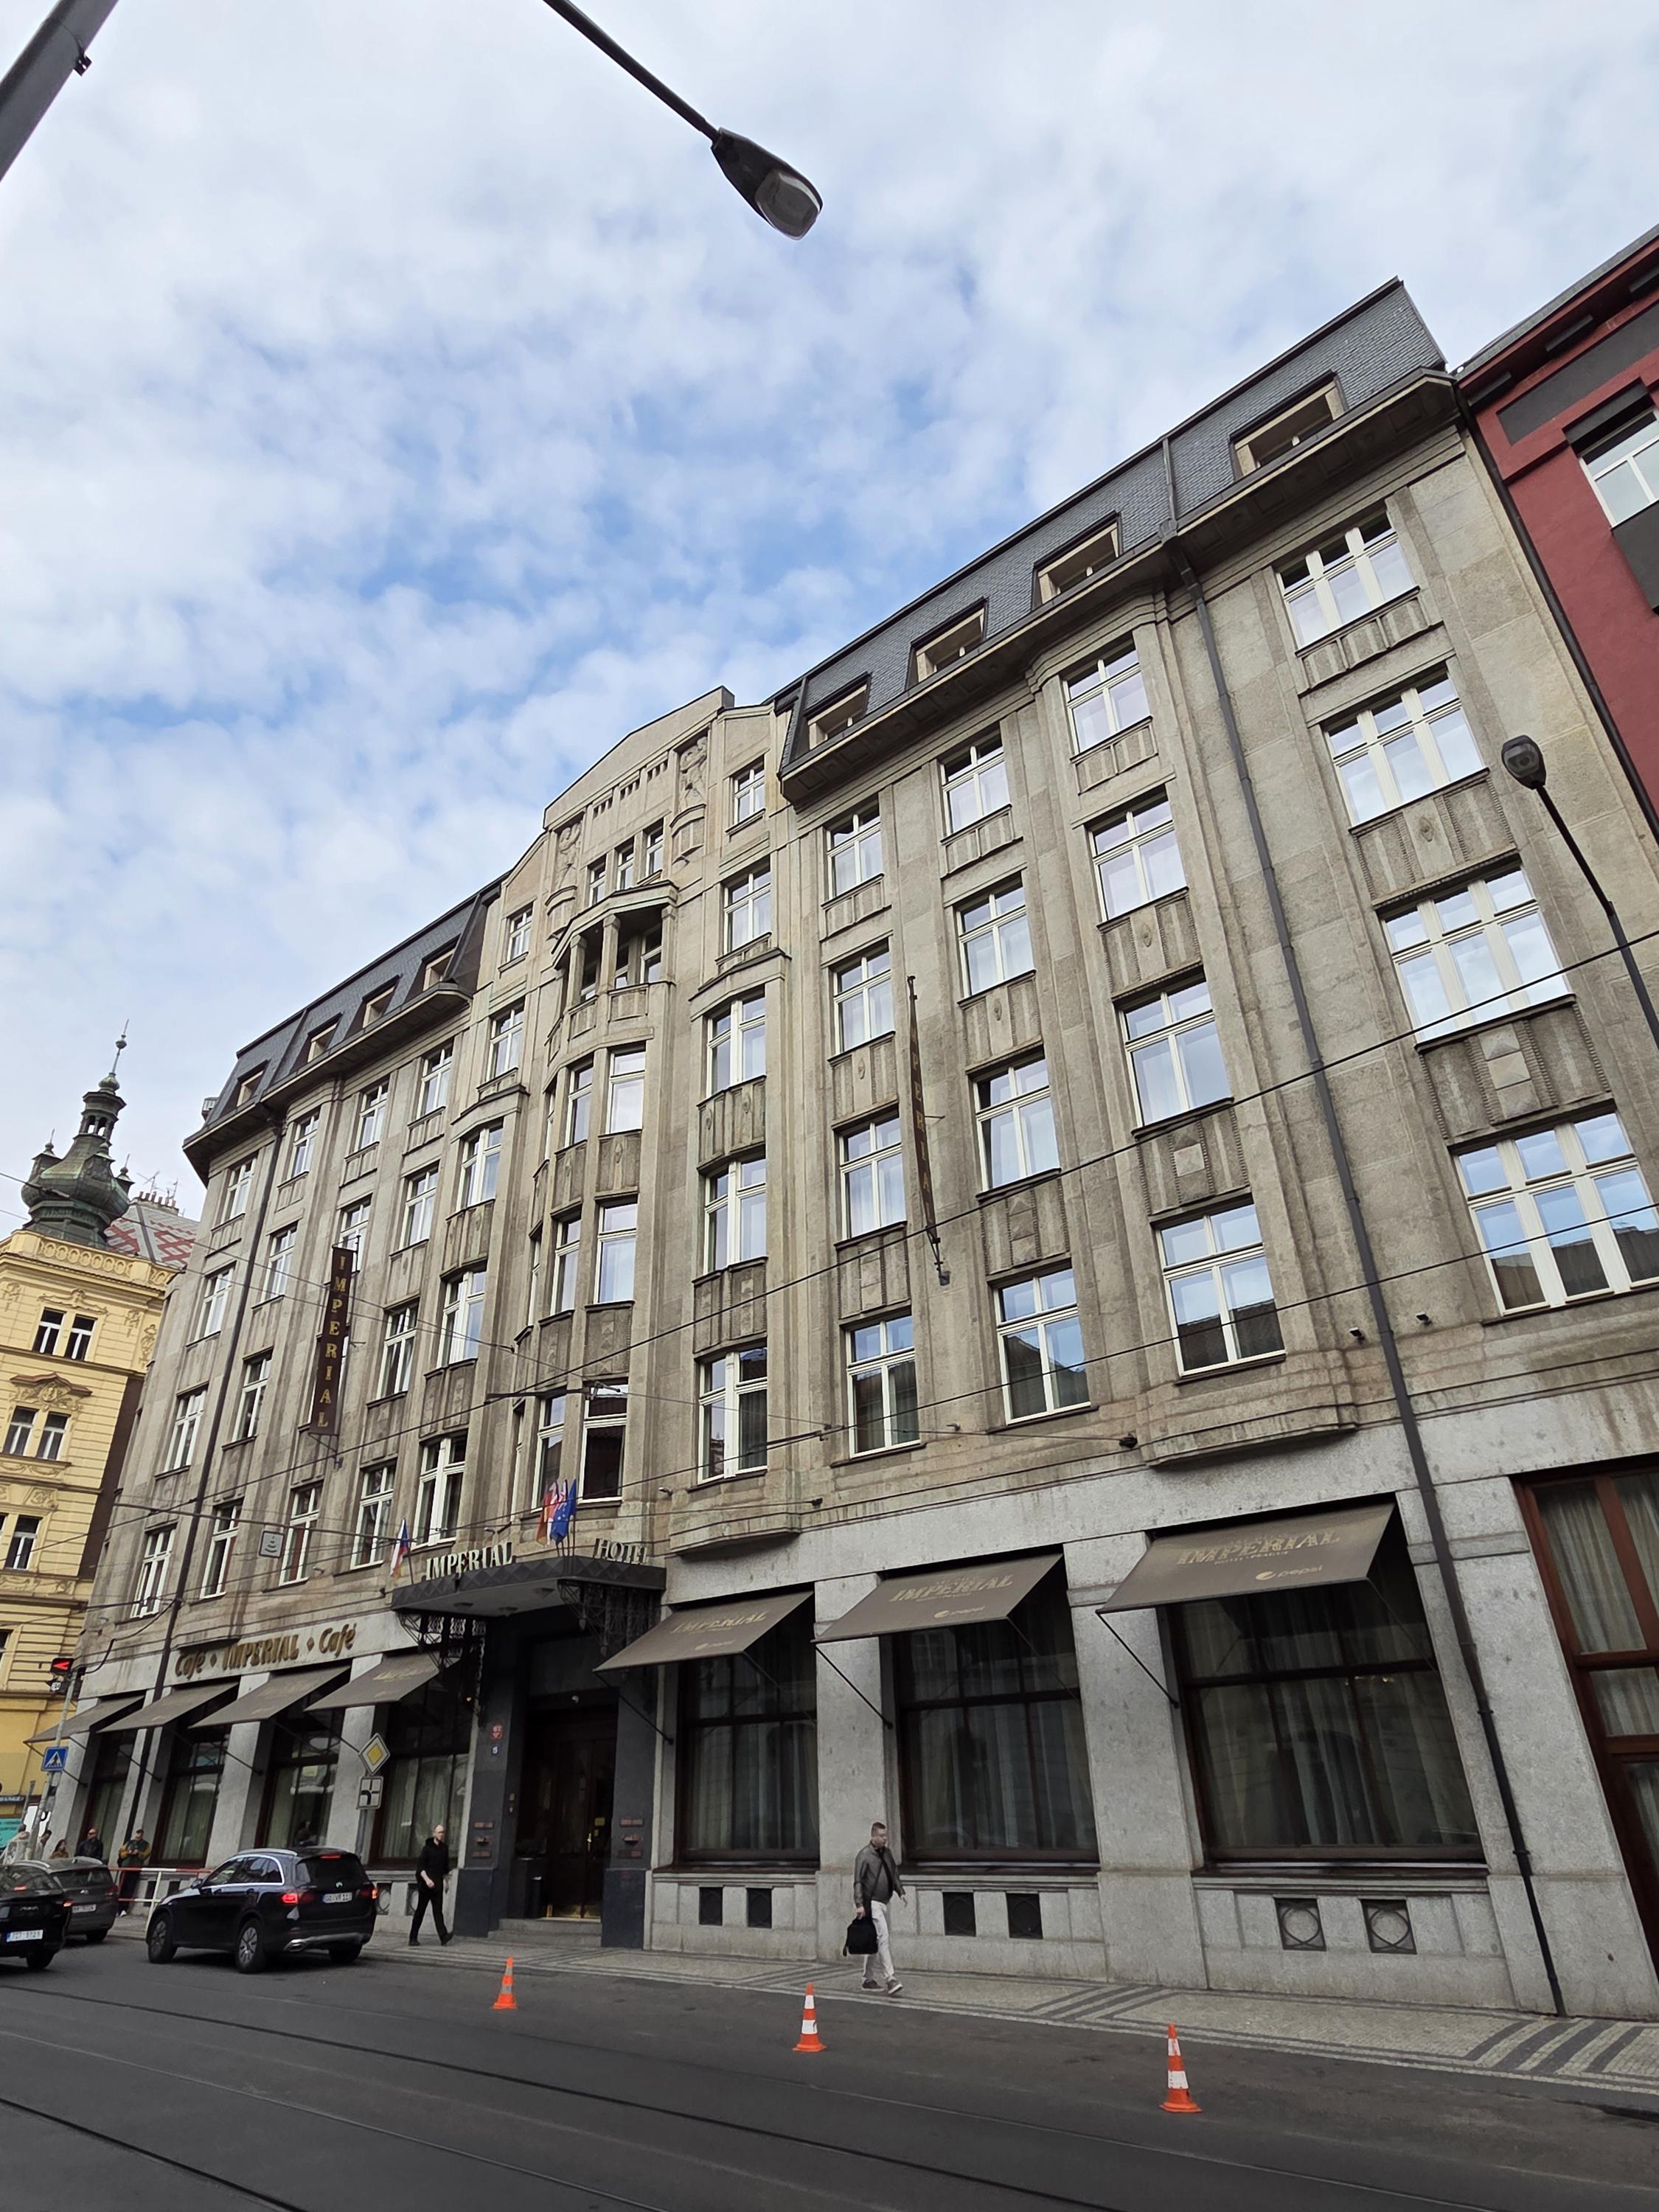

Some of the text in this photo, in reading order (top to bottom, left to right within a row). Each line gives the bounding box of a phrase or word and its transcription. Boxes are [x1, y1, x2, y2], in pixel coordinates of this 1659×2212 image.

[318, 1256, 347, 1427] IMPERIAL
[425, 1540, 513, 1581] IMPERIAL
[593, 1537, 650, 1565] HOTEL
[1176, 1531, 1340, 1565] IMPERIAL
[889, 1575, 1013, 1602] IMPERIAL
[221, 1634, 299, 1671] IMPERIAL
[319, 1622, 358, 1658] Café
